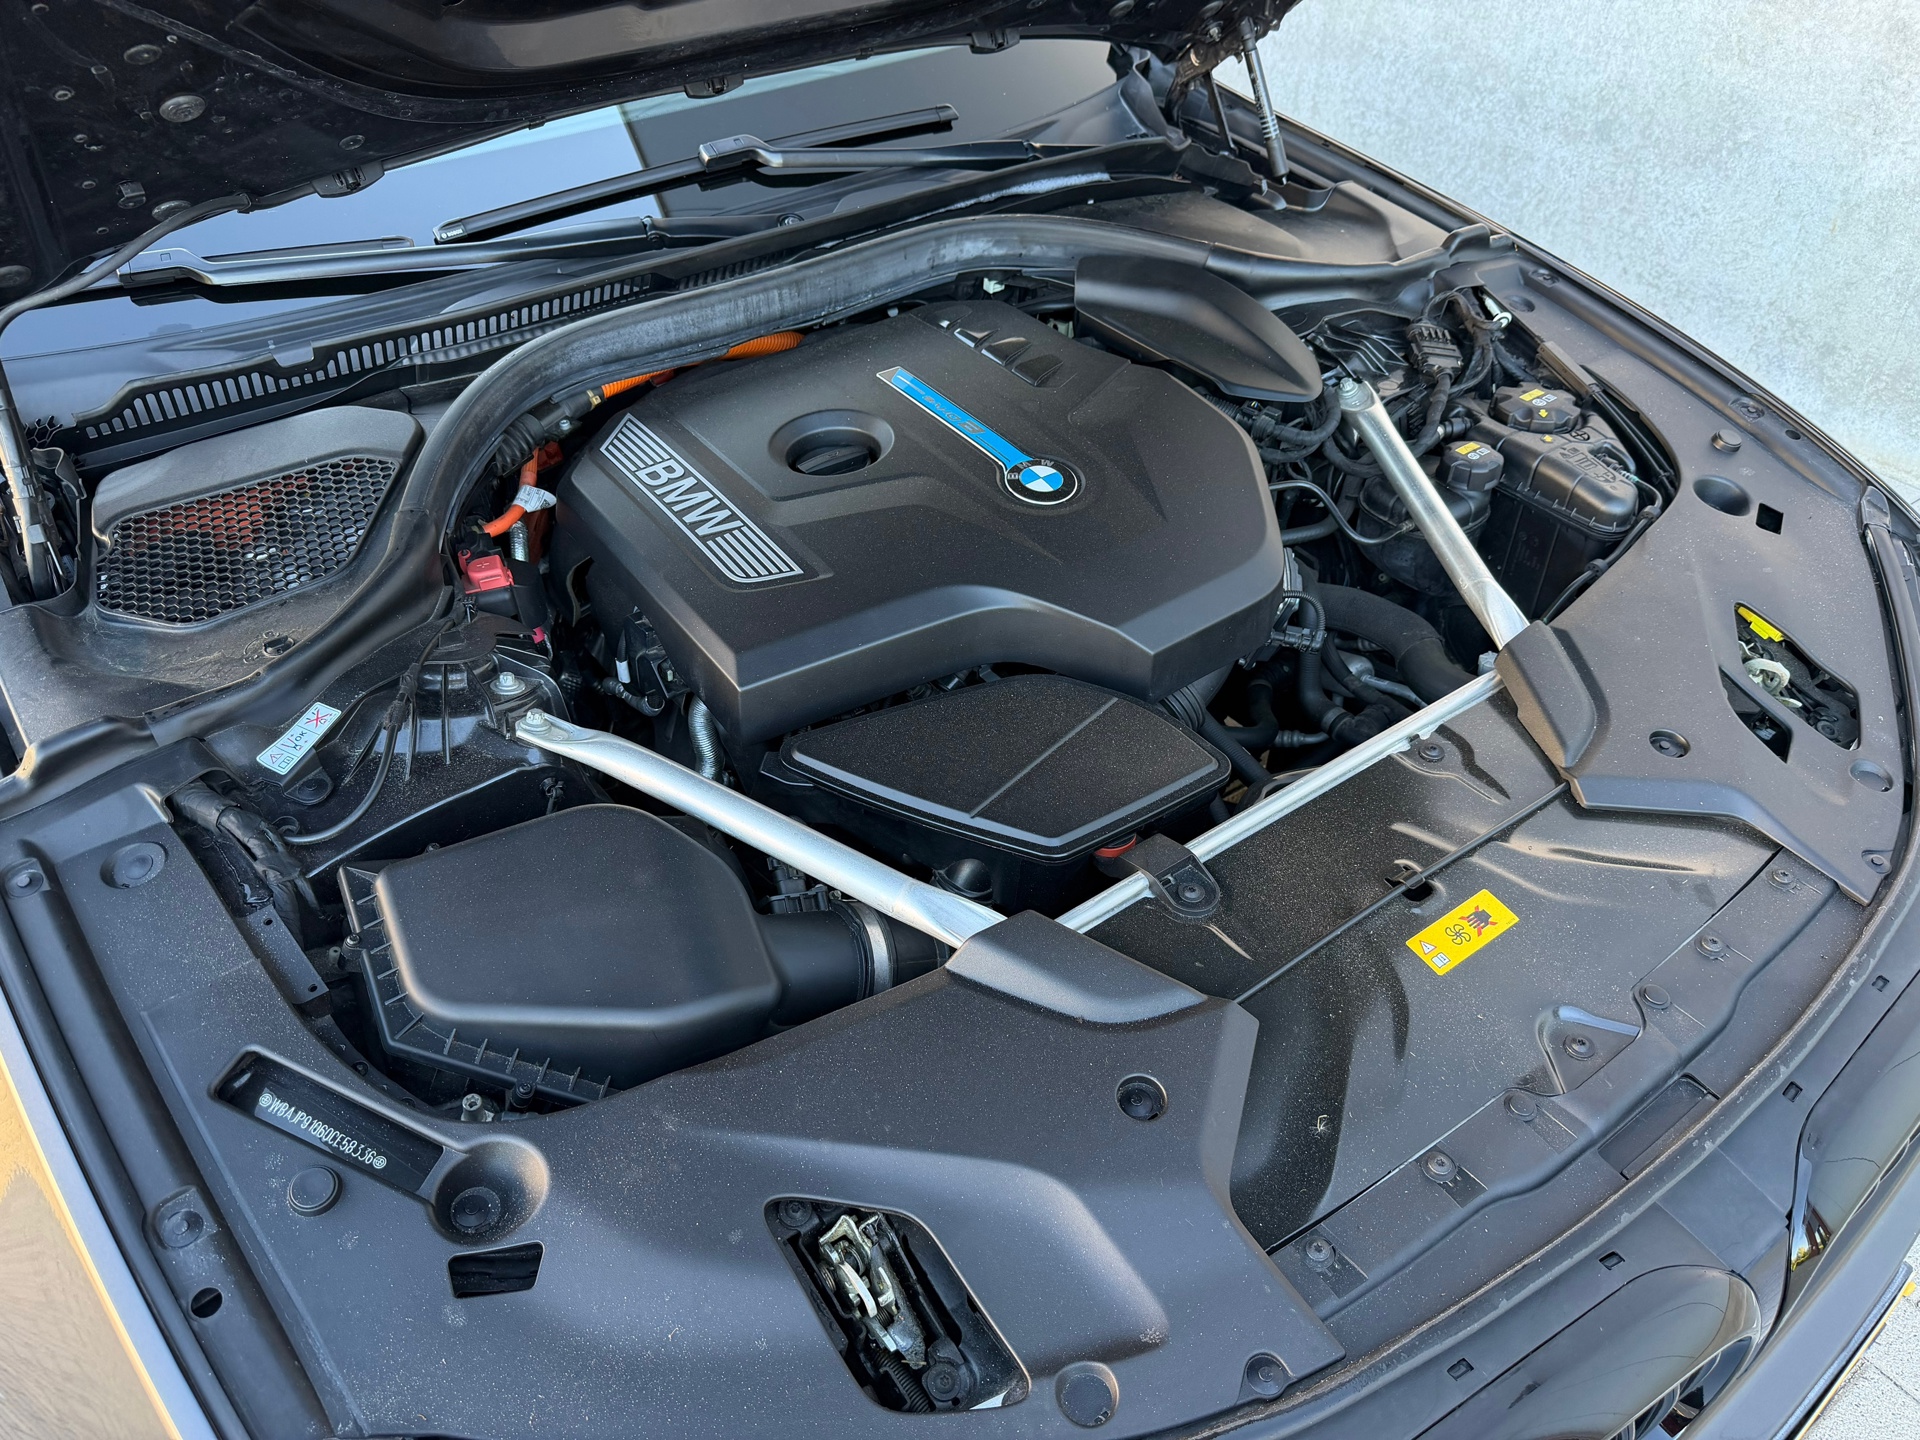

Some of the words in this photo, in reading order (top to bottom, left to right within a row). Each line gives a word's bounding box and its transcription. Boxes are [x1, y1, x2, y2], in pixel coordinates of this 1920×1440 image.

[1007, 459, 1055, 480] BMW
[634, 458, 744, 537] BMW
[294, 730, 308, 742] OK
